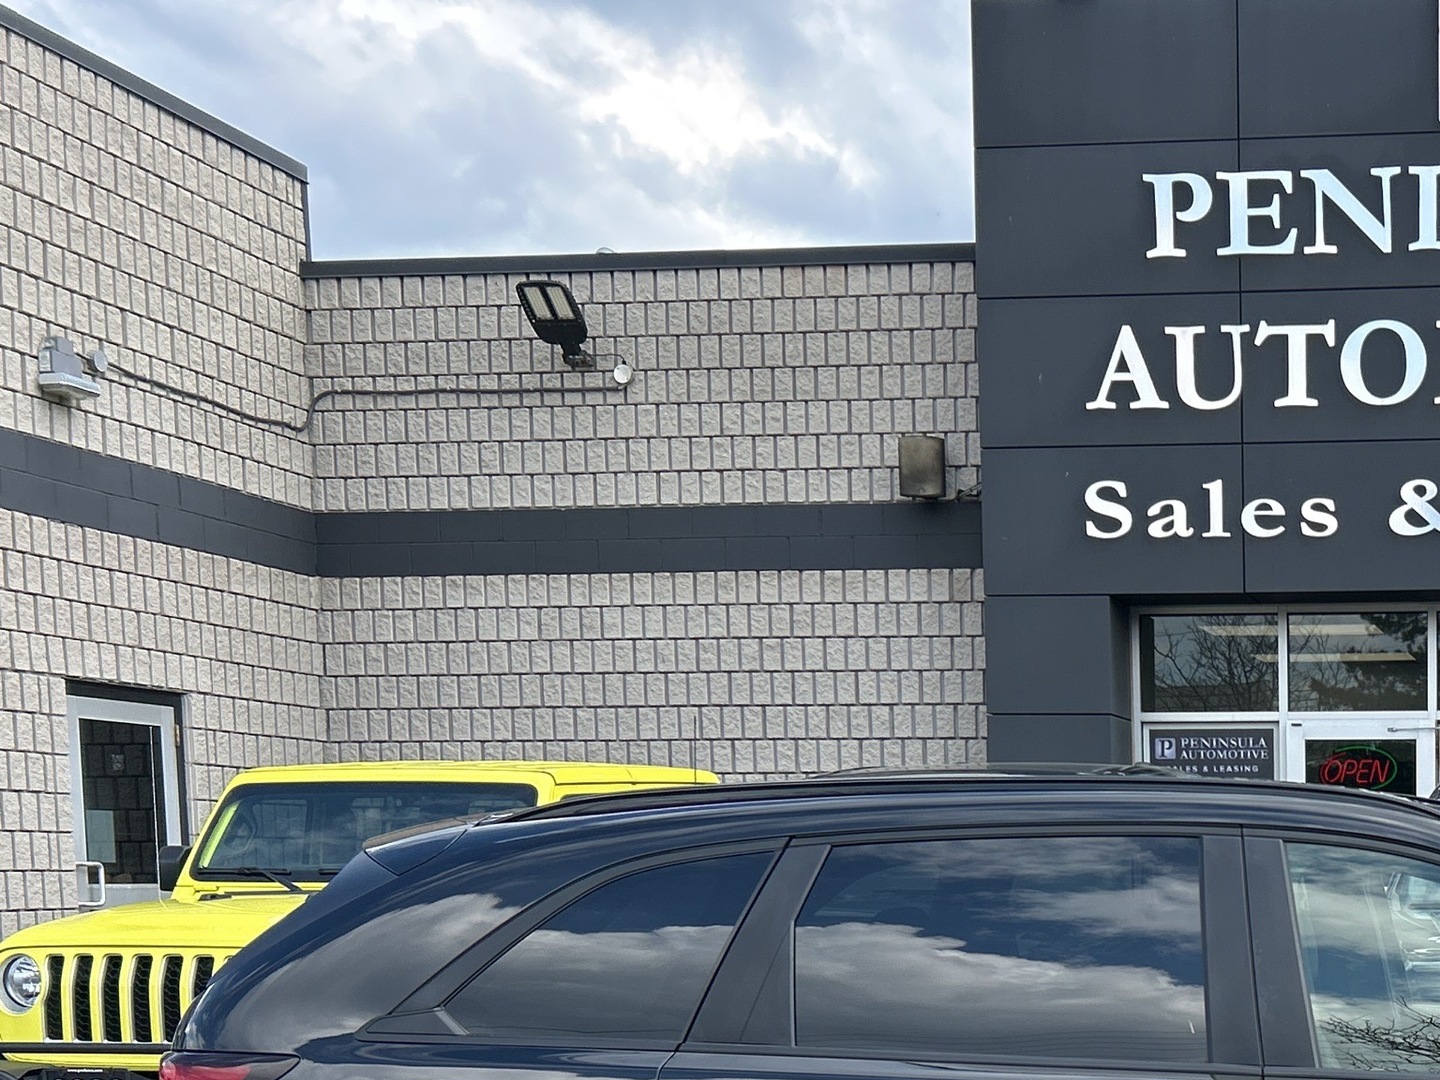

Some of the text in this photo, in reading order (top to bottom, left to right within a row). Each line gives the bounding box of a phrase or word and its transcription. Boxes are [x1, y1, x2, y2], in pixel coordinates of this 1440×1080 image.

[1084, 478, 1339, 539] Sales
[1159, 740, 1173, 758] P
[1180, 737, 1267, 748] PENINSULA
[1180, 749, 1269, 760] AUTOMOTIVE
[1324, 759, 1390, 783] OPEN
